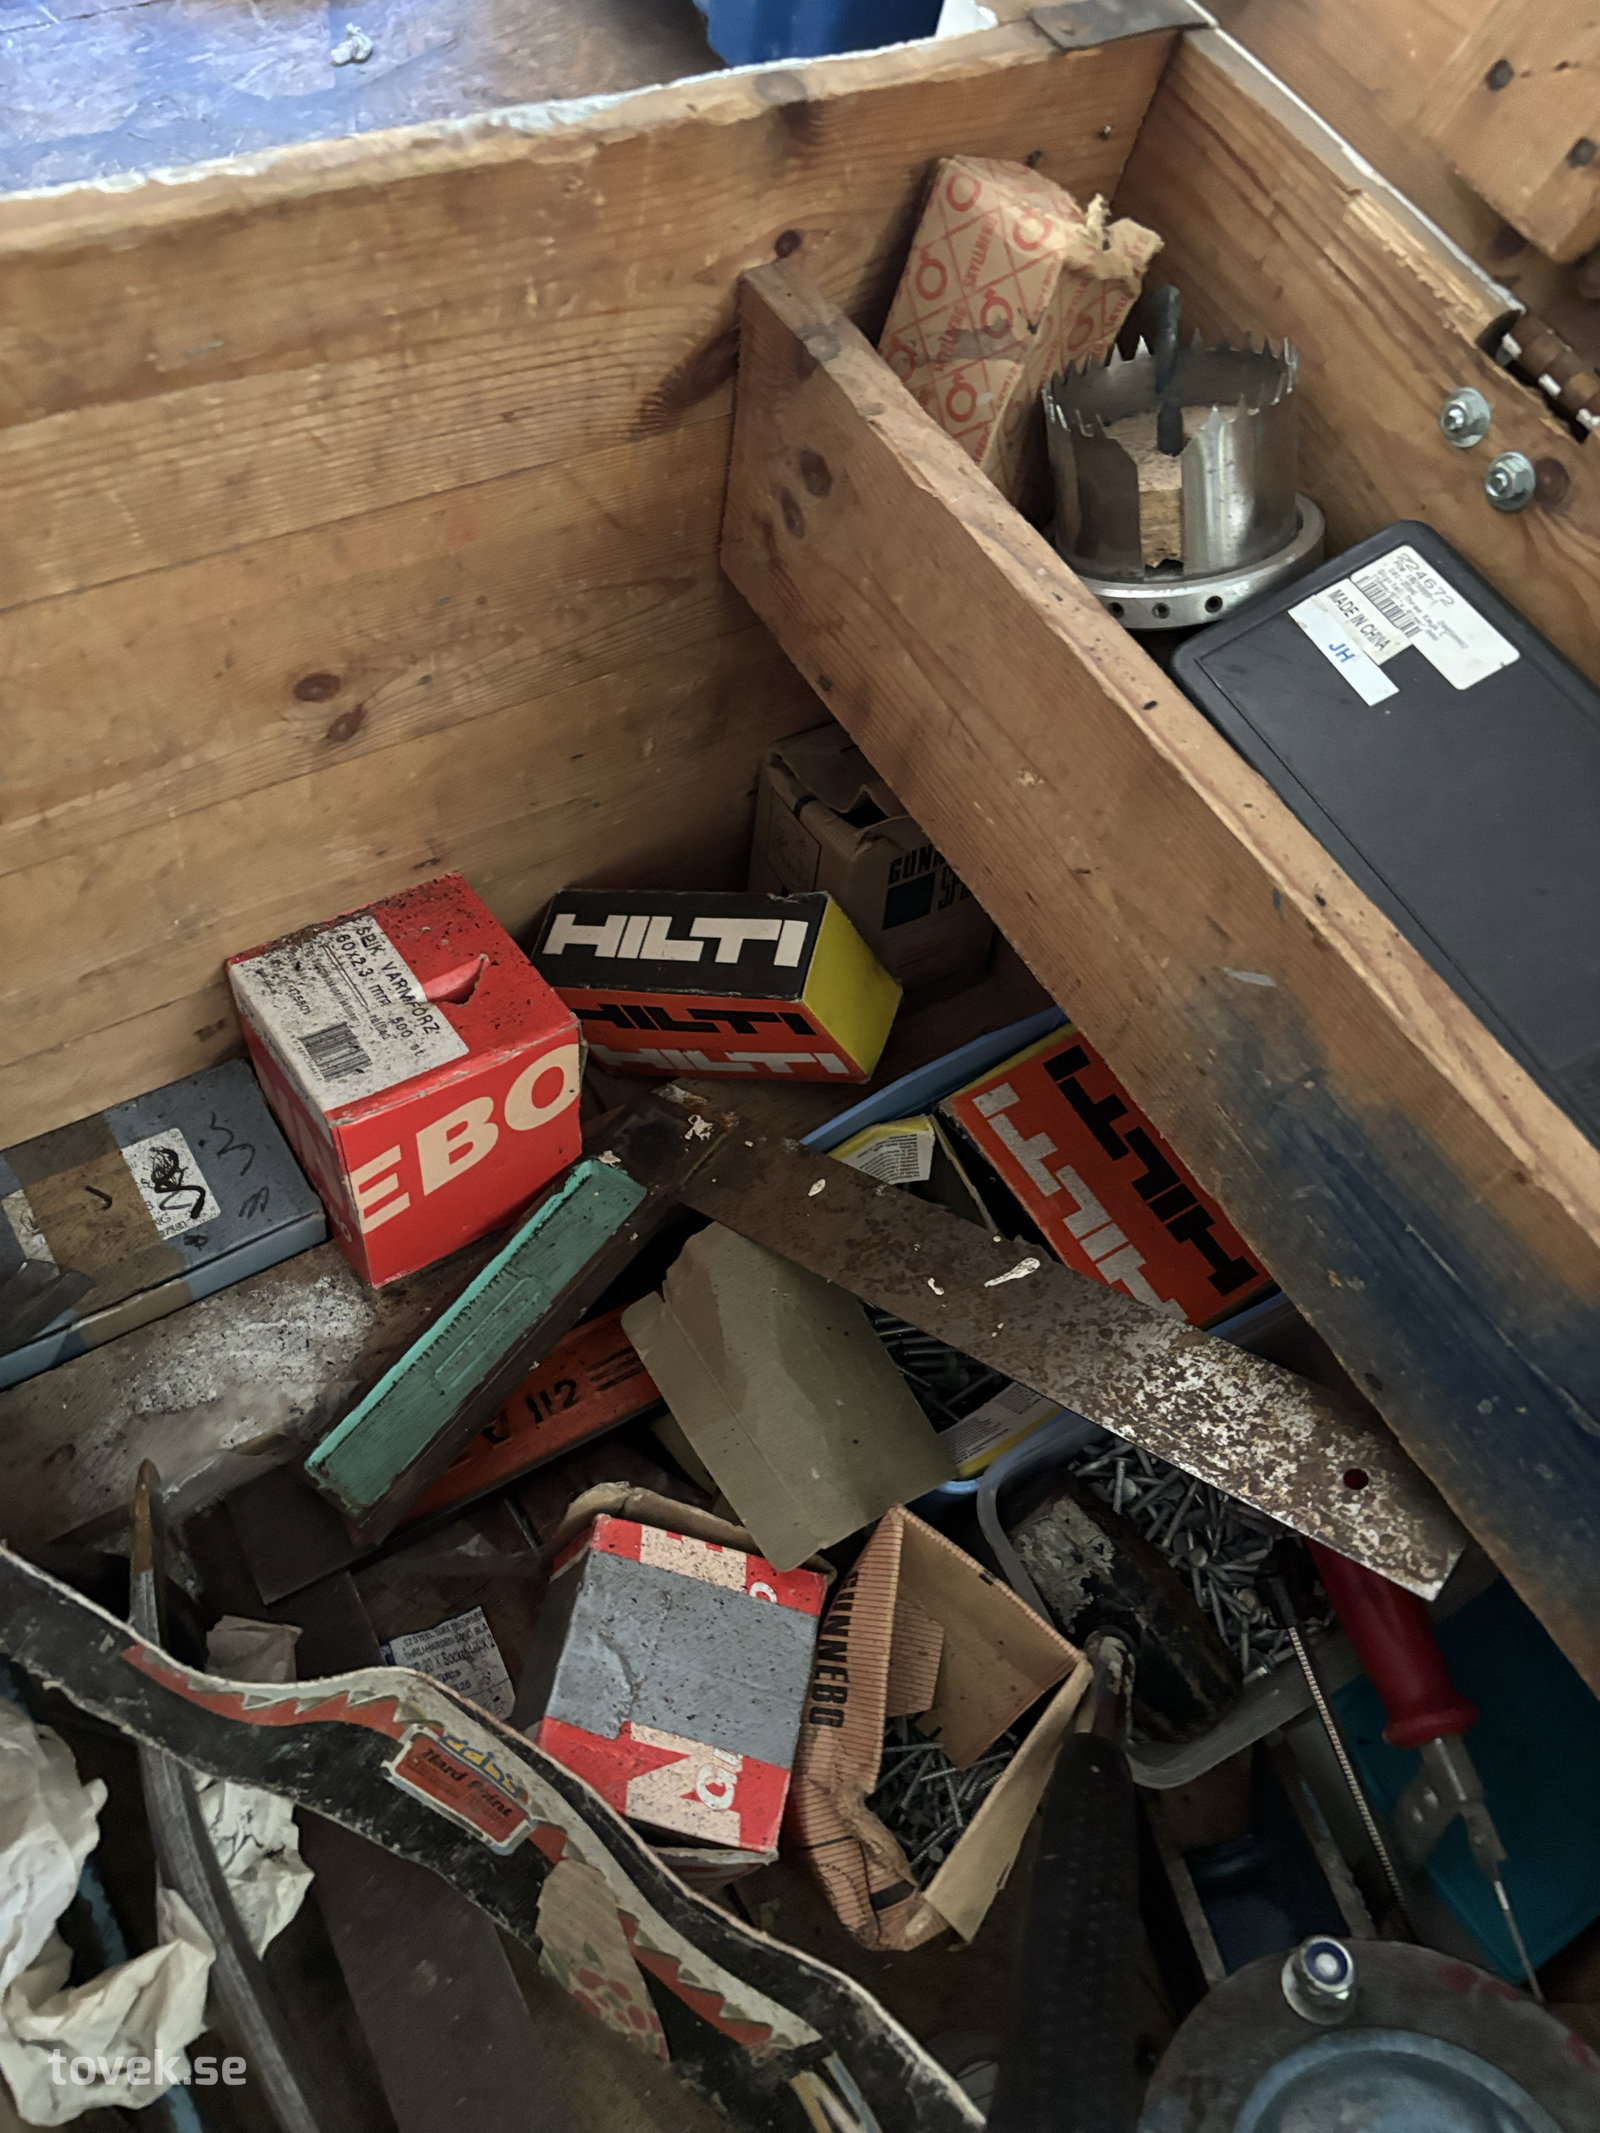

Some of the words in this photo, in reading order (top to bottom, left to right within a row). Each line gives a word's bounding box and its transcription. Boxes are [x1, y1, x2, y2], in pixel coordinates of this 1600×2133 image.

[1327, 589, 1359, 618] MADE
[1350, 612, 1368, 628] IN
[1360, 623, 1391, 652] CHINA
[1328, 642, 1356, 663] JH
[541, 912, 809, 968] HILTI
[1042, 1044, 1259, 1297] HILTI
